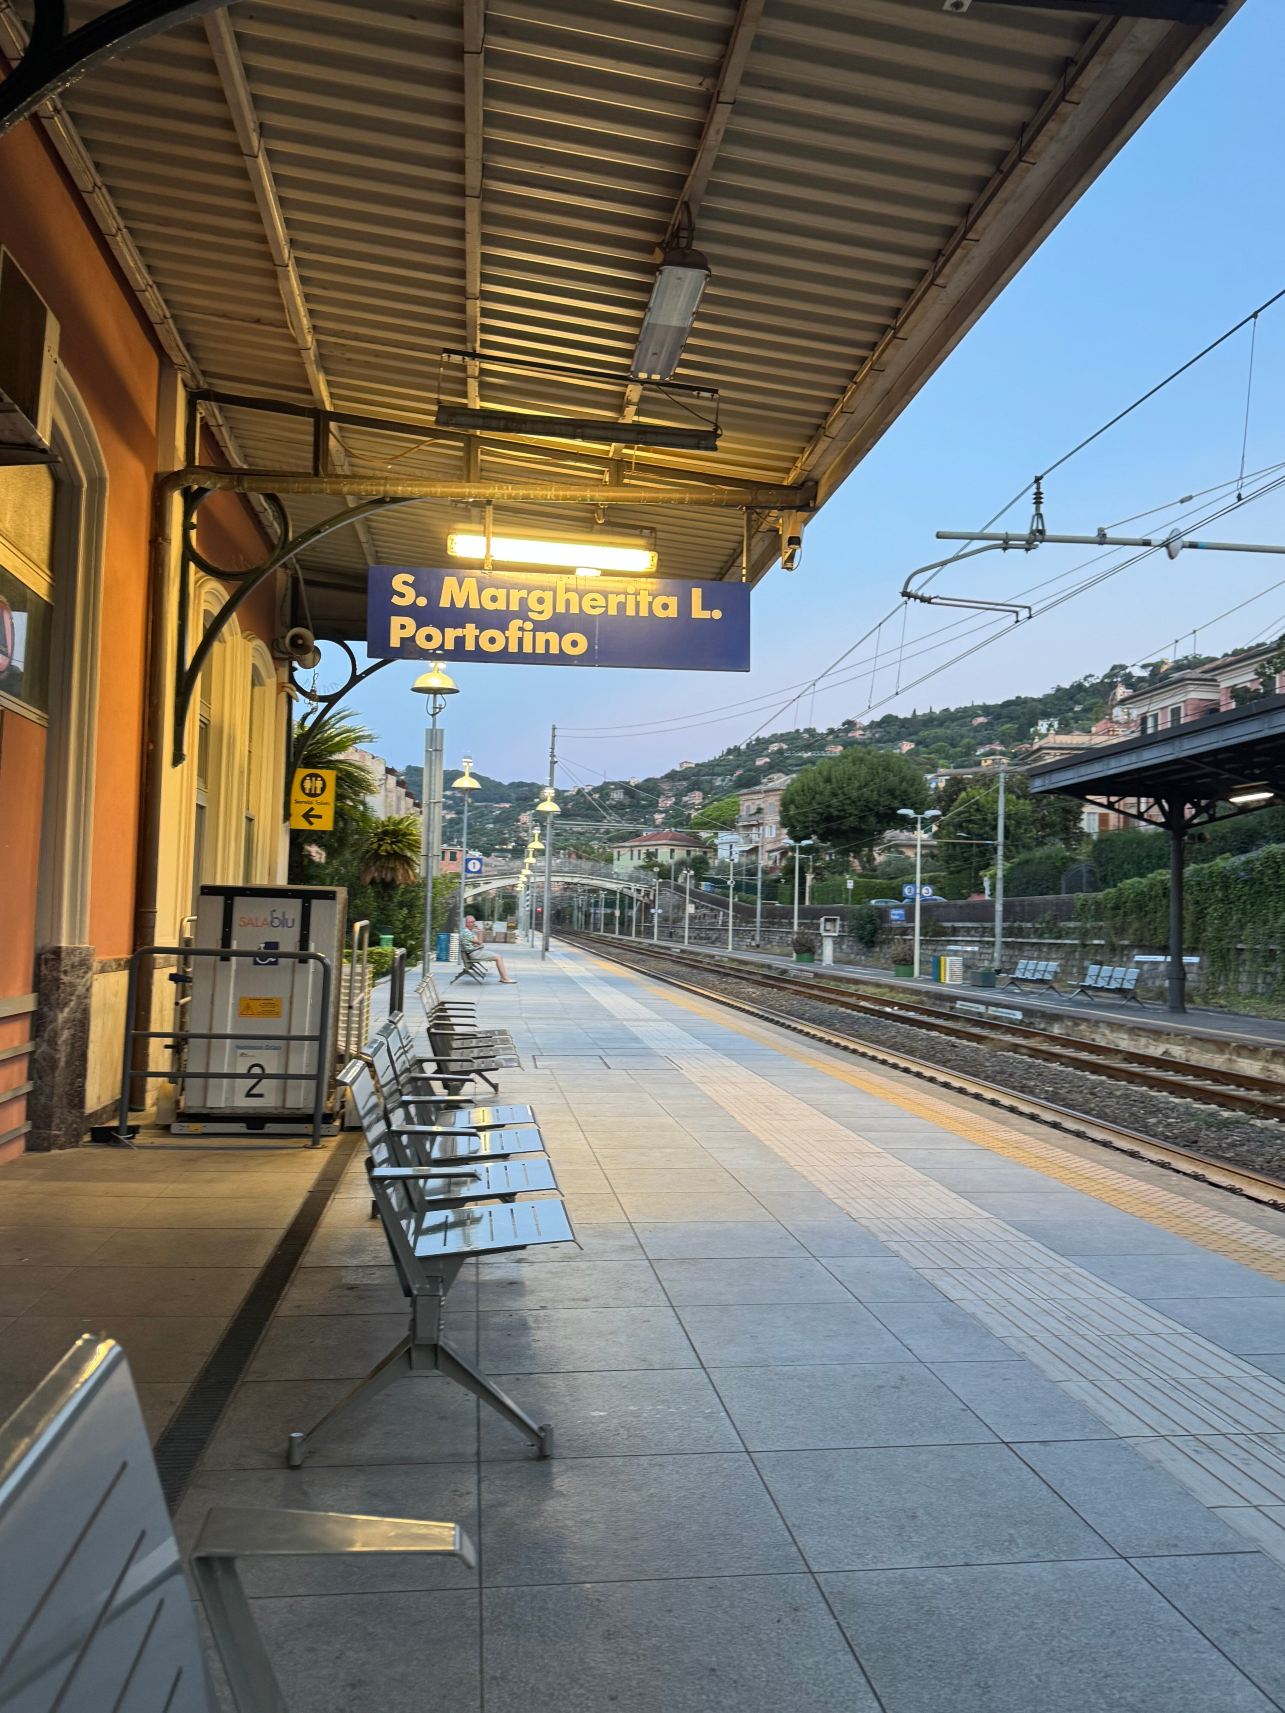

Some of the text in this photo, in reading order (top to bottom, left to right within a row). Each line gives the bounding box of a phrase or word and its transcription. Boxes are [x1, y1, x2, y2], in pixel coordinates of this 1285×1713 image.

[391, 573, 723, 621] S. Margherita L.
[389, 615, 588, 656] Portofino
[245, 1063, 265, 1098] 2
